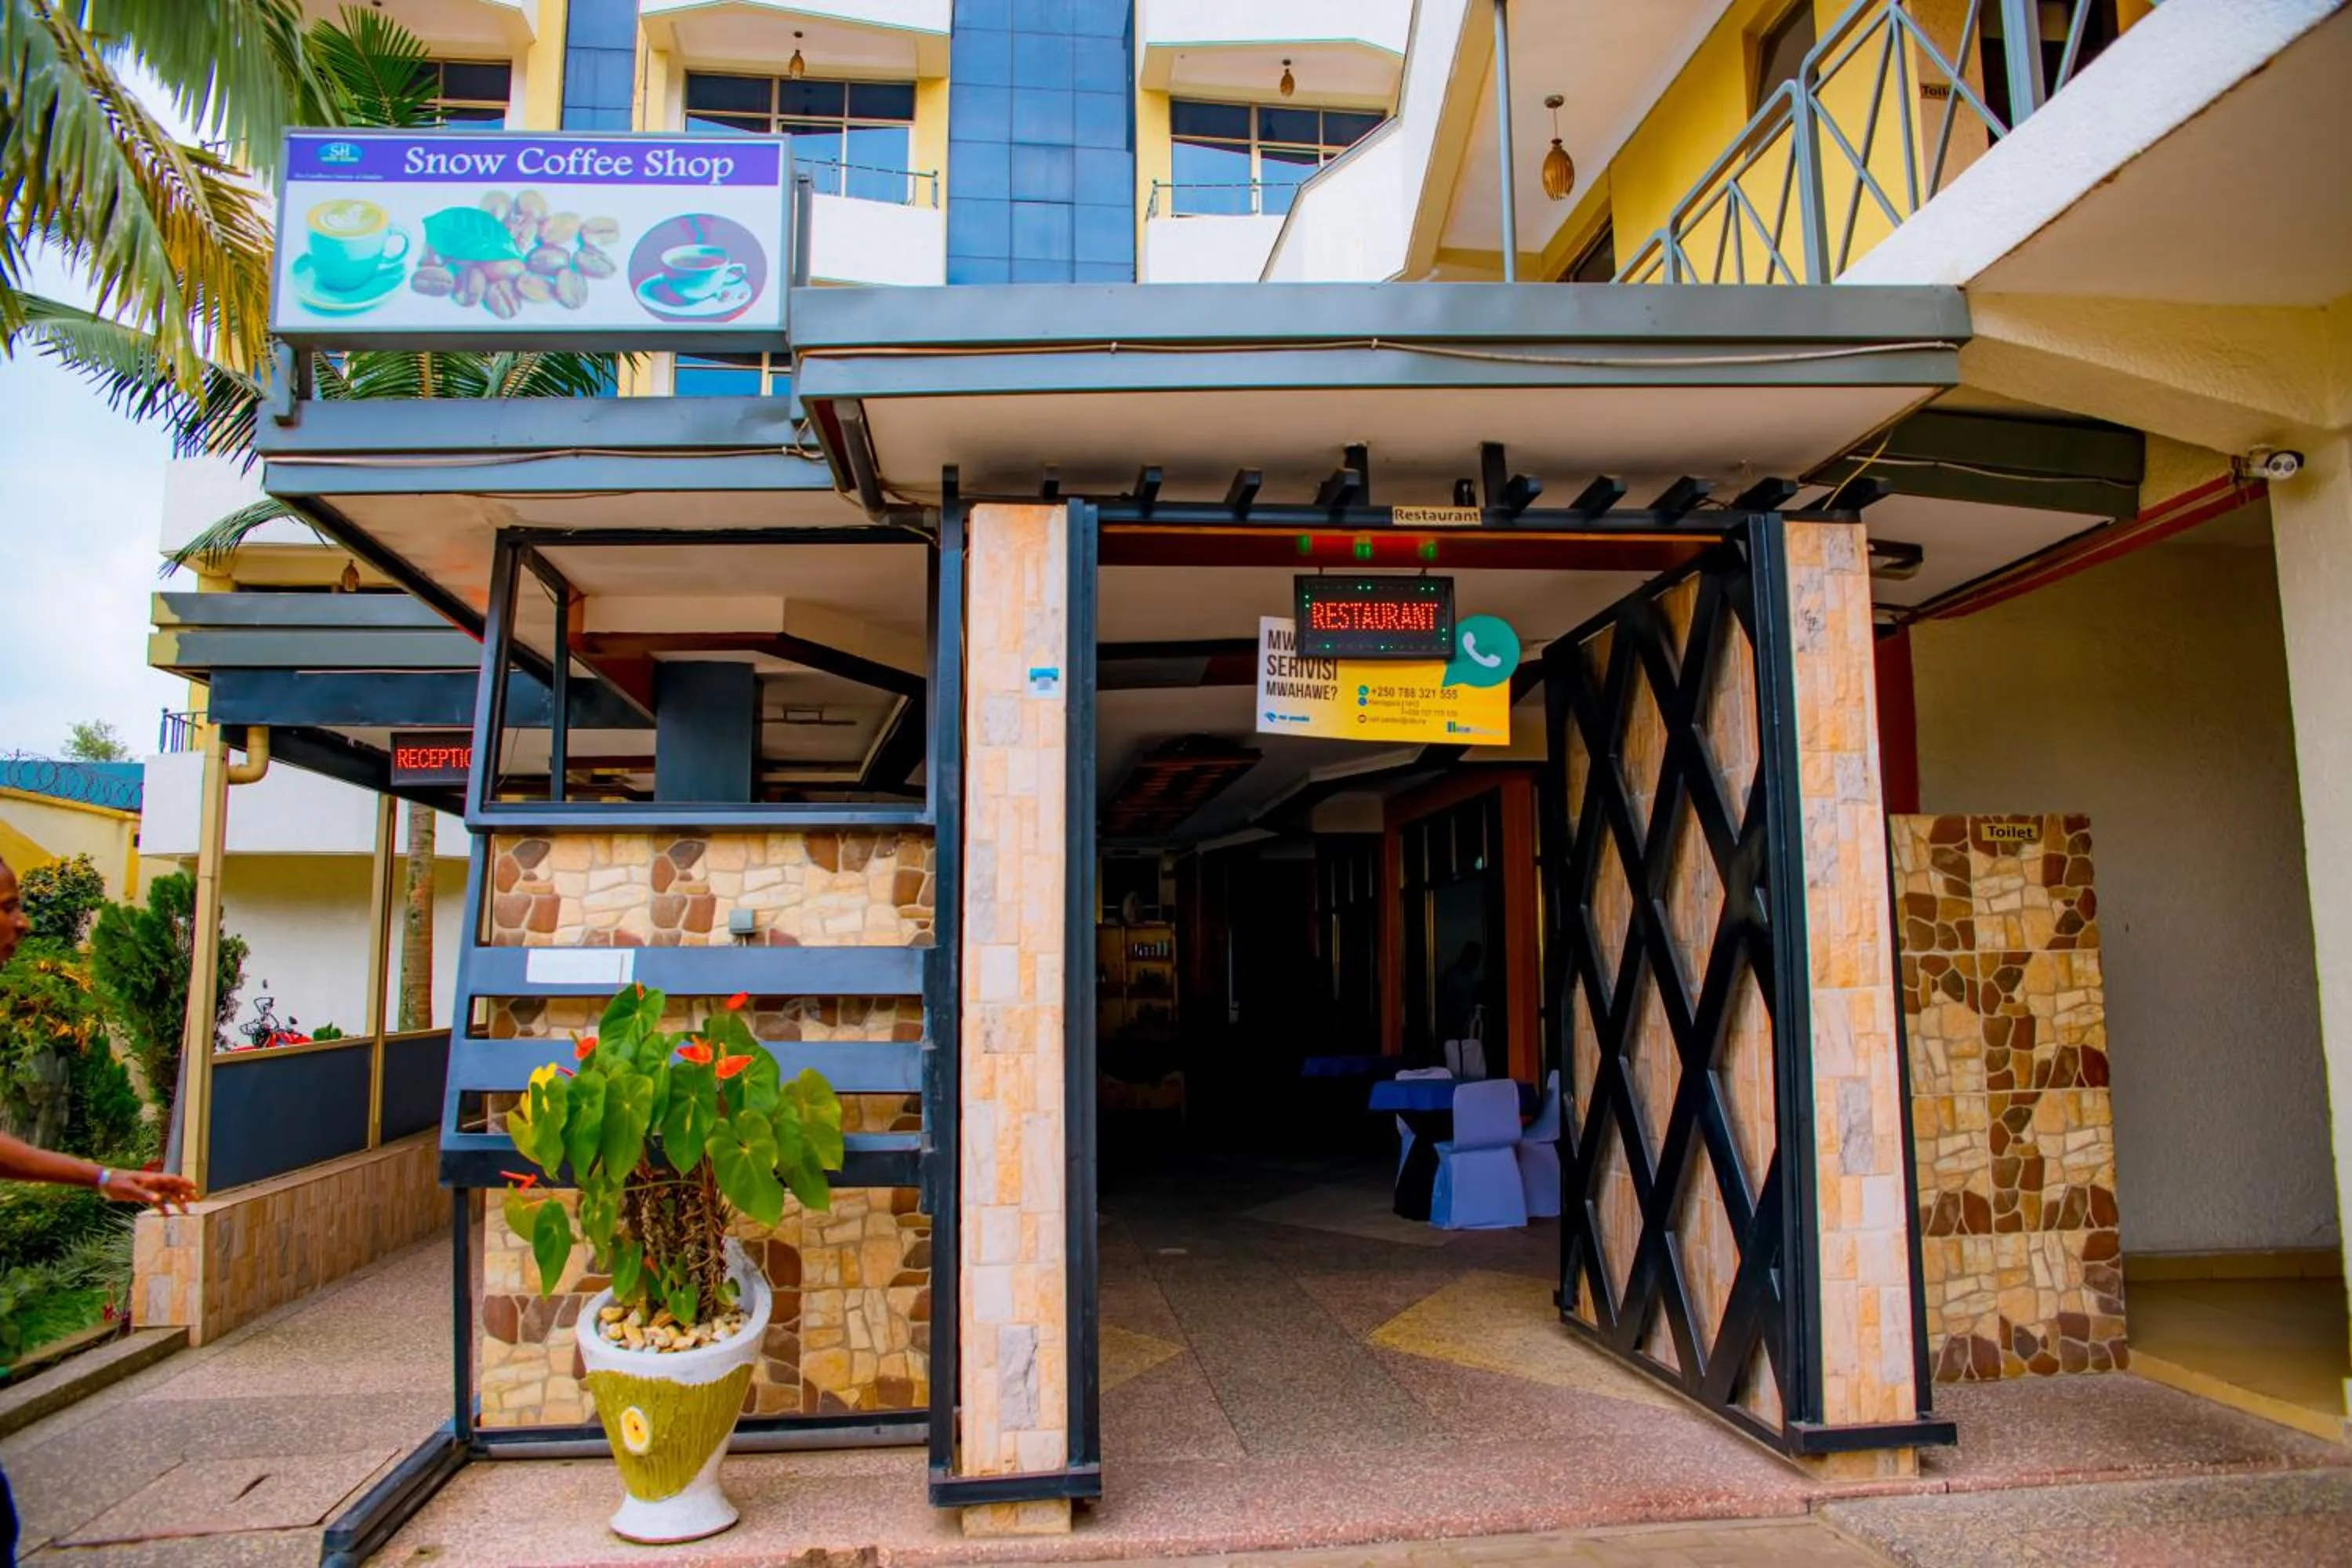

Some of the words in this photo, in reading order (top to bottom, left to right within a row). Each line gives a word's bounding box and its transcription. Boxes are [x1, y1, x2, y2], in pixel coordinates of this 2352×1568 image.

[1922, 86, 1951, 95] Toil
[330, 143, 352, 156] SH
[405, 147, 506, 174] Snow
[517, 147, 633, 177] Coffee
[644, 149, 735, 185] Shop
[1395, 509, 1480, 522] Restaurant
[1312, 602, 1438, 630] RESTAURANT
[1266, 655, 1338, 681] SERIVISI
[1266, 681, 1338, 701] MWAHAWE?
[1419, 688, 1436, 699] 321
[397, 748, 474, 768] RECEPTIO
[1987, 826, 2033, 838] Toilet
